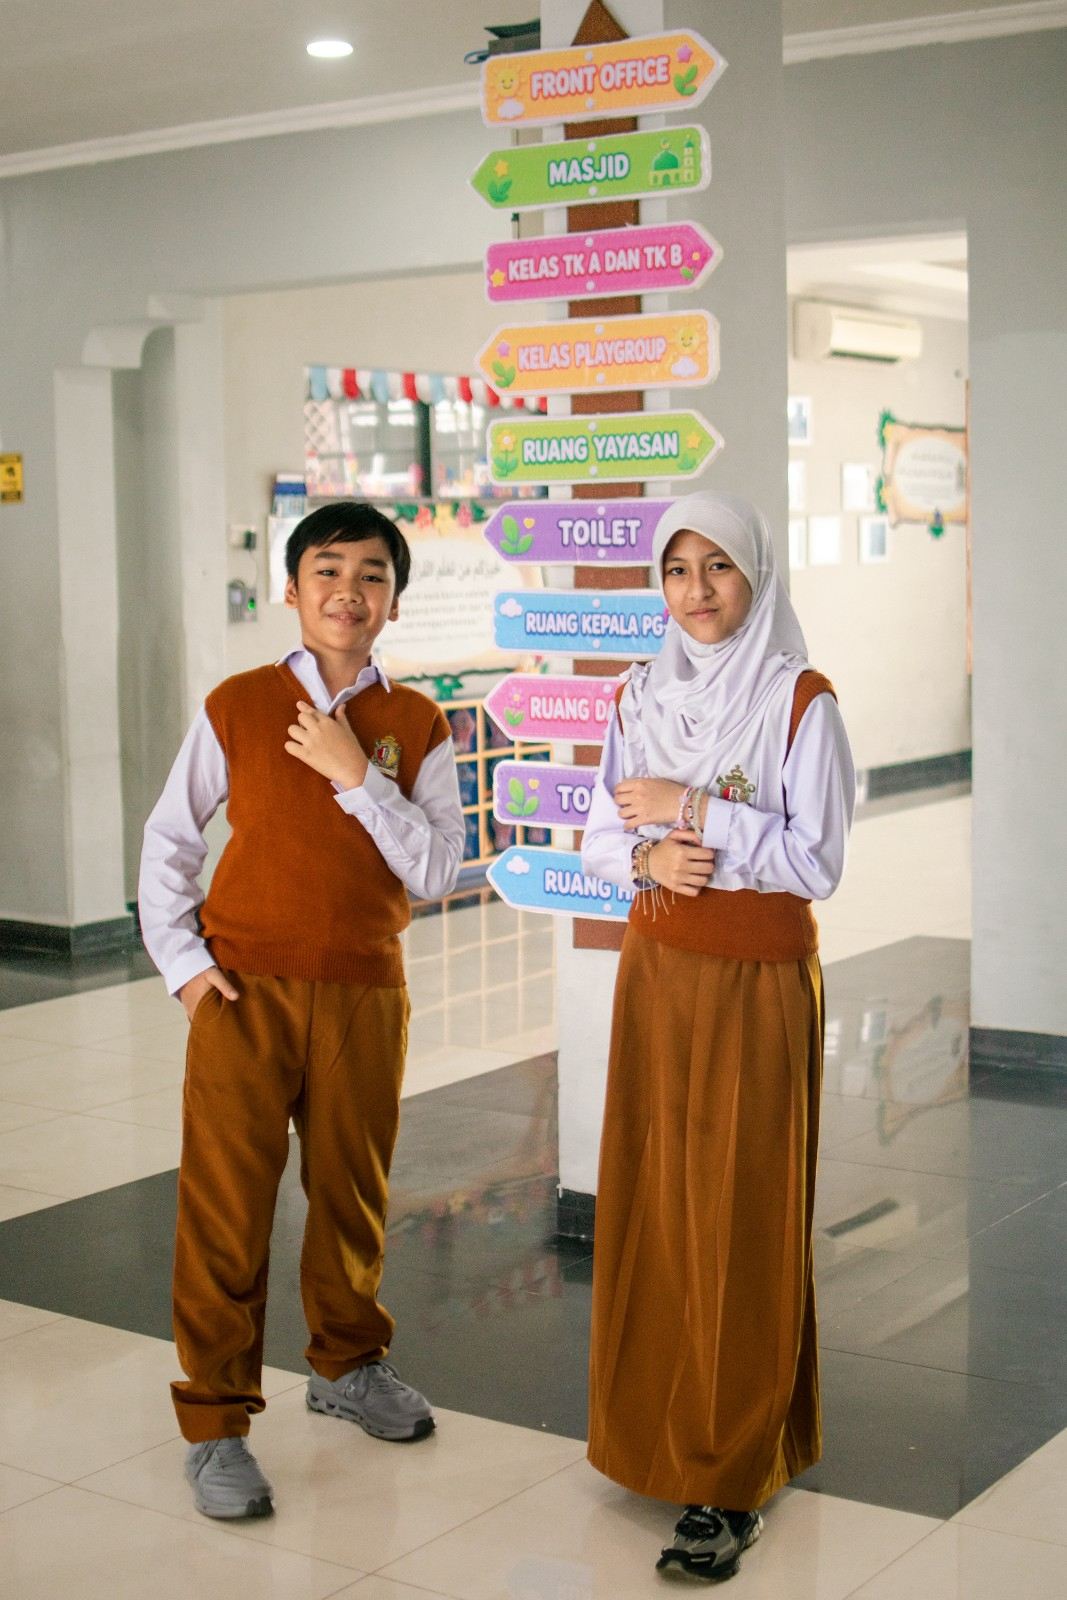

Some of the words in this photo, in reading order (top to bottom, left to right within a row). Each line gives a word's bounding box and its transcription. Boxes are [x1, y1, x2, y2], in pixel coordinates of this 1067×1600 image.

[531, 66, 596, 99] FRONT
[600, 56, 670, 90] OFFICE
[549, 153, 629, 186] MASJID
[508, 258, 559, 281] KELAS
[563, 255, 585, 276] TK
[588, 252, 601, 273] A
[604, 249, 640, 272] DAN
[643, 246, 667, 269] TK
[670, 244, 682, 266] B
[518, 345, 571, 370] KELAS
[575, 337, 667, 367] PLAYGROUP
[522, 437, 588, 463] RUANG
[593, 432, 679, 459] YAYASAN
[558, 519, 641, 546] TOILET
[526, 612, 578, 635] RUANG
[581, 613, 640, 637] KEPALA
[529, 695, 590, 721] RUANG
[544, 868, 612, 900] RUANG
